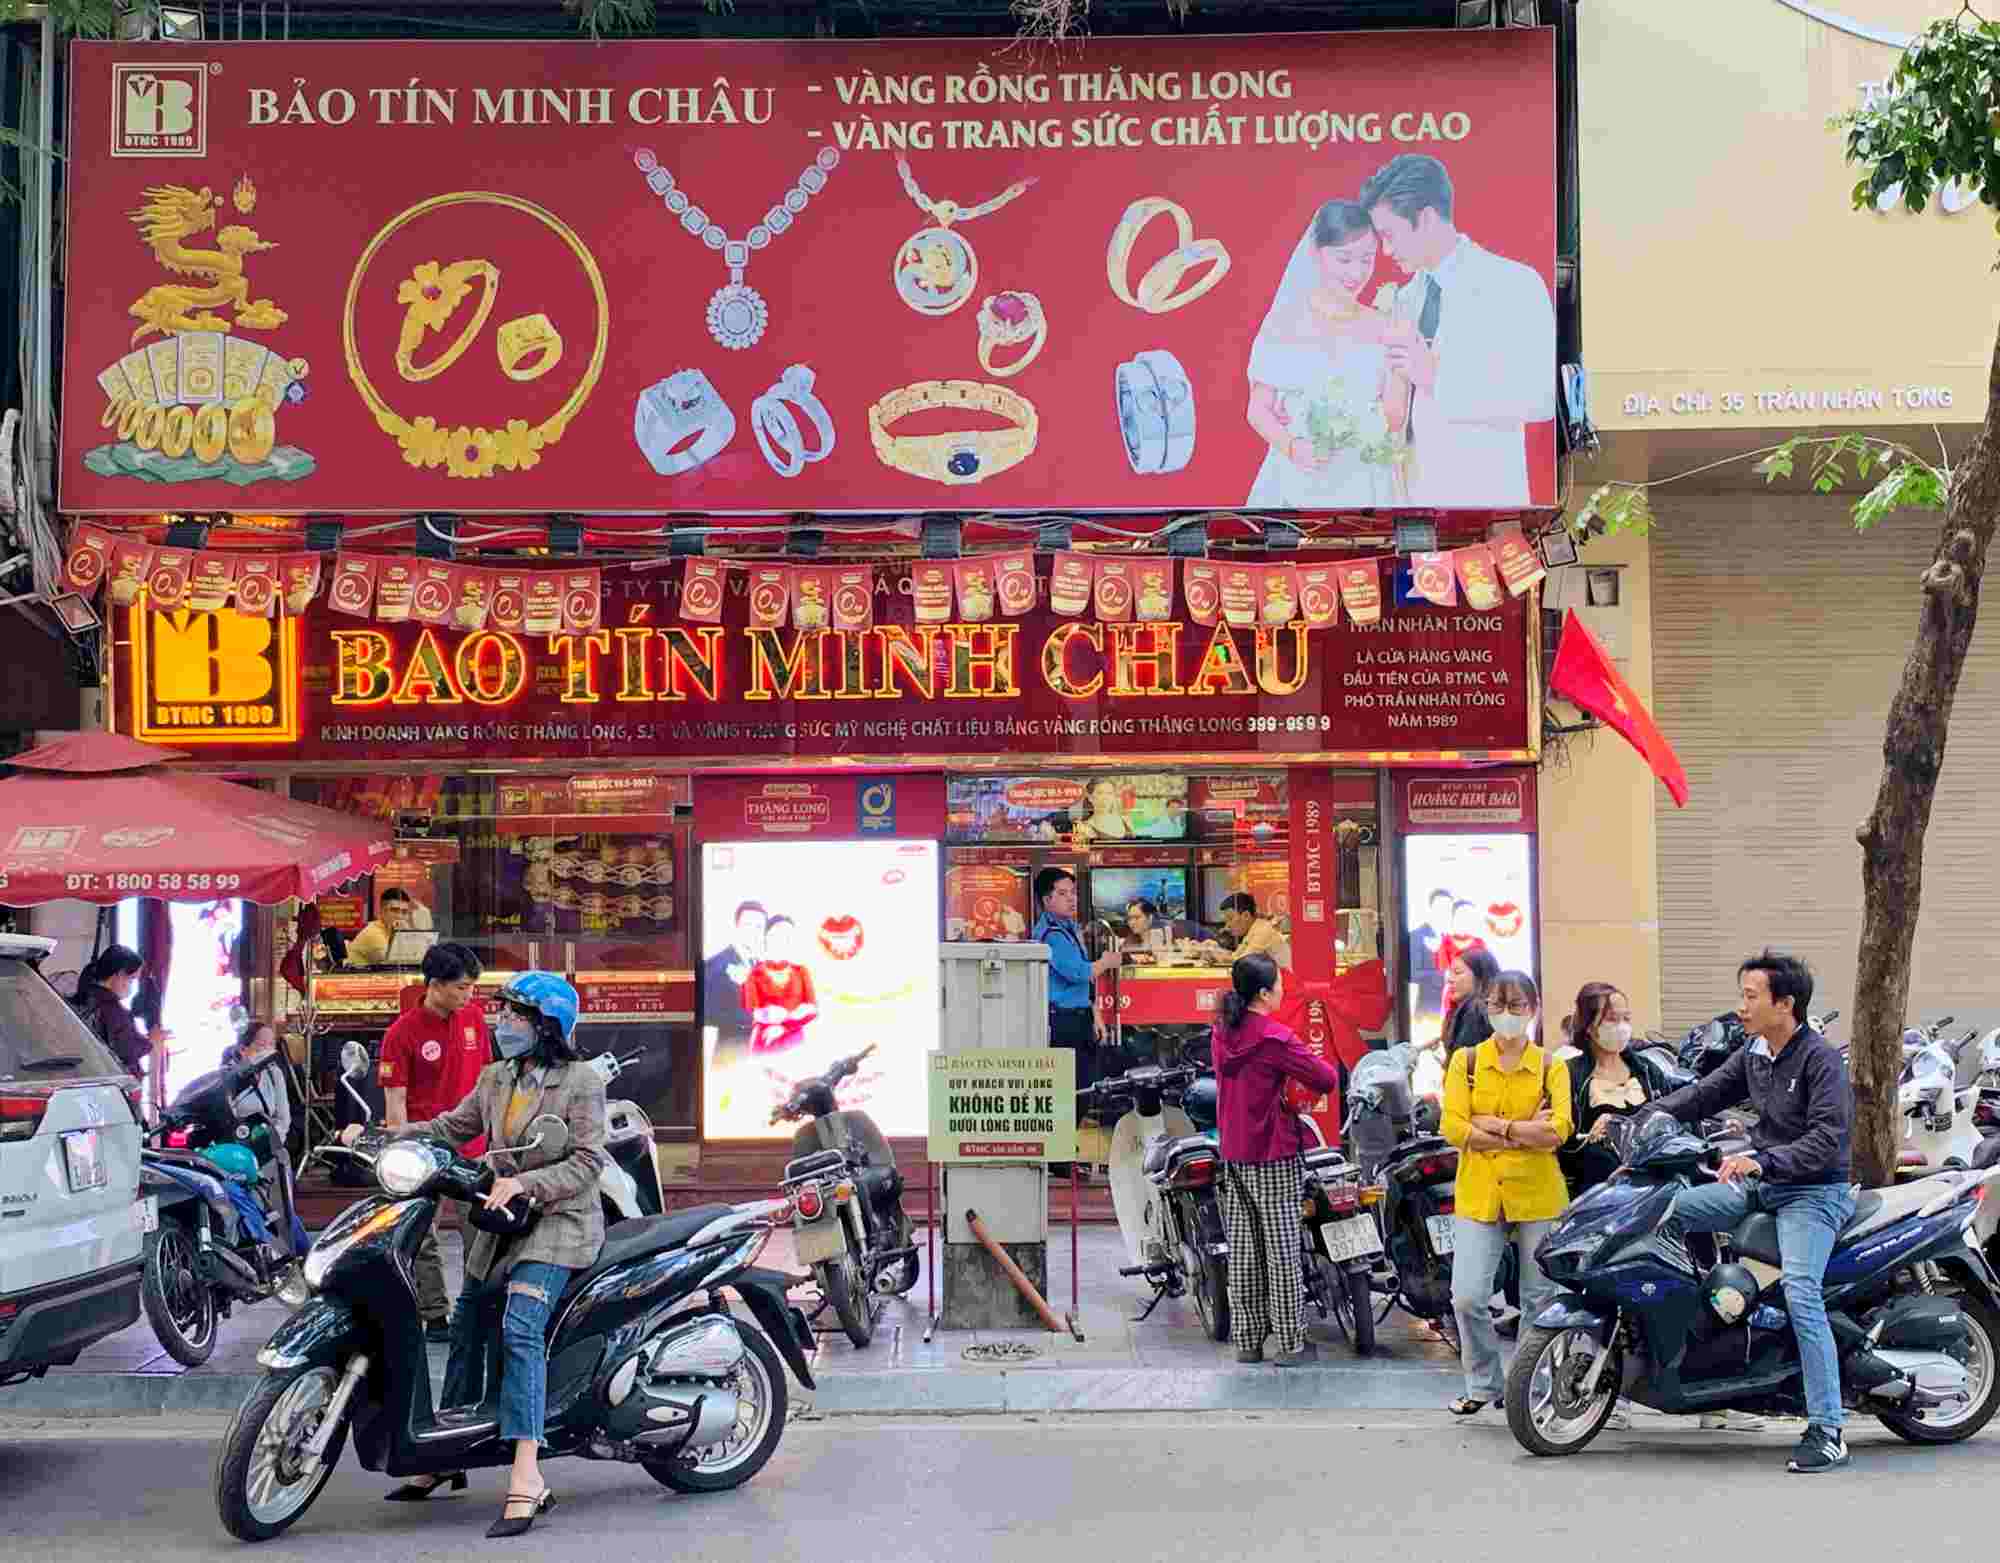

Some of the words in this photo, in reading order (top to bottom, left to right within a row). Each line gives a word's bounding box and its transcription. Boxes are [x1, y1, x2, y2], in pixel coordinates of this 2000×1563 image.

[834, 69, 935, 104] VÀNG
[944, 62, 1049, 103] RỒNG
[1058, 65, 1181, 101] THĂNG
[1191, 70, 1292, 99] LONG
[248, 78, 356, 124] BẢO
[369, 78, 456, 124] TÍN
[472, 88, 615, 124] MINH
[628, 77, 776, 124] CHÂU
[832, 113, 934, 149] VÀNG
[942, 120, 1063, 149] TRANG
[1071, 111, 1143, 147] SỨC
[1151, 104, 1247, 145] CHẤT
[1256, 109, 1382, 150] LƯỢNG
[1391, 111, 1471, 142] CAO
[1719, 391, 1744, 416] 35
[744, 624, 1020, 700] MINH
[1445, 671, 1486, 685] BTMC
[156, 706, 214, 725] BTMC
[222, 705, 273, 724] 1989
[1426, 714, 1459, 728] 1989
[321, 725, 358, 741] KINH
[363, 725, 420, 741] DOANH
[424, 722, 469, 741] VÀNG
[1199, 717, 1242, 733] LONG
[1305, 800, 1322, 833] 1989
[1305, 839, 1322, 893] BTMC
[106, 873, 152, 890] 1800
[158, 873, 182, 890] 58
[187, 873, 211, 889] 58
[215, 873, 240, 889] 99
[1099, 994, 1131, 1009] 199
[949, 1091, 1004, 1114] KHÔNG
[1034, 1095, 1054, 1114] XE
